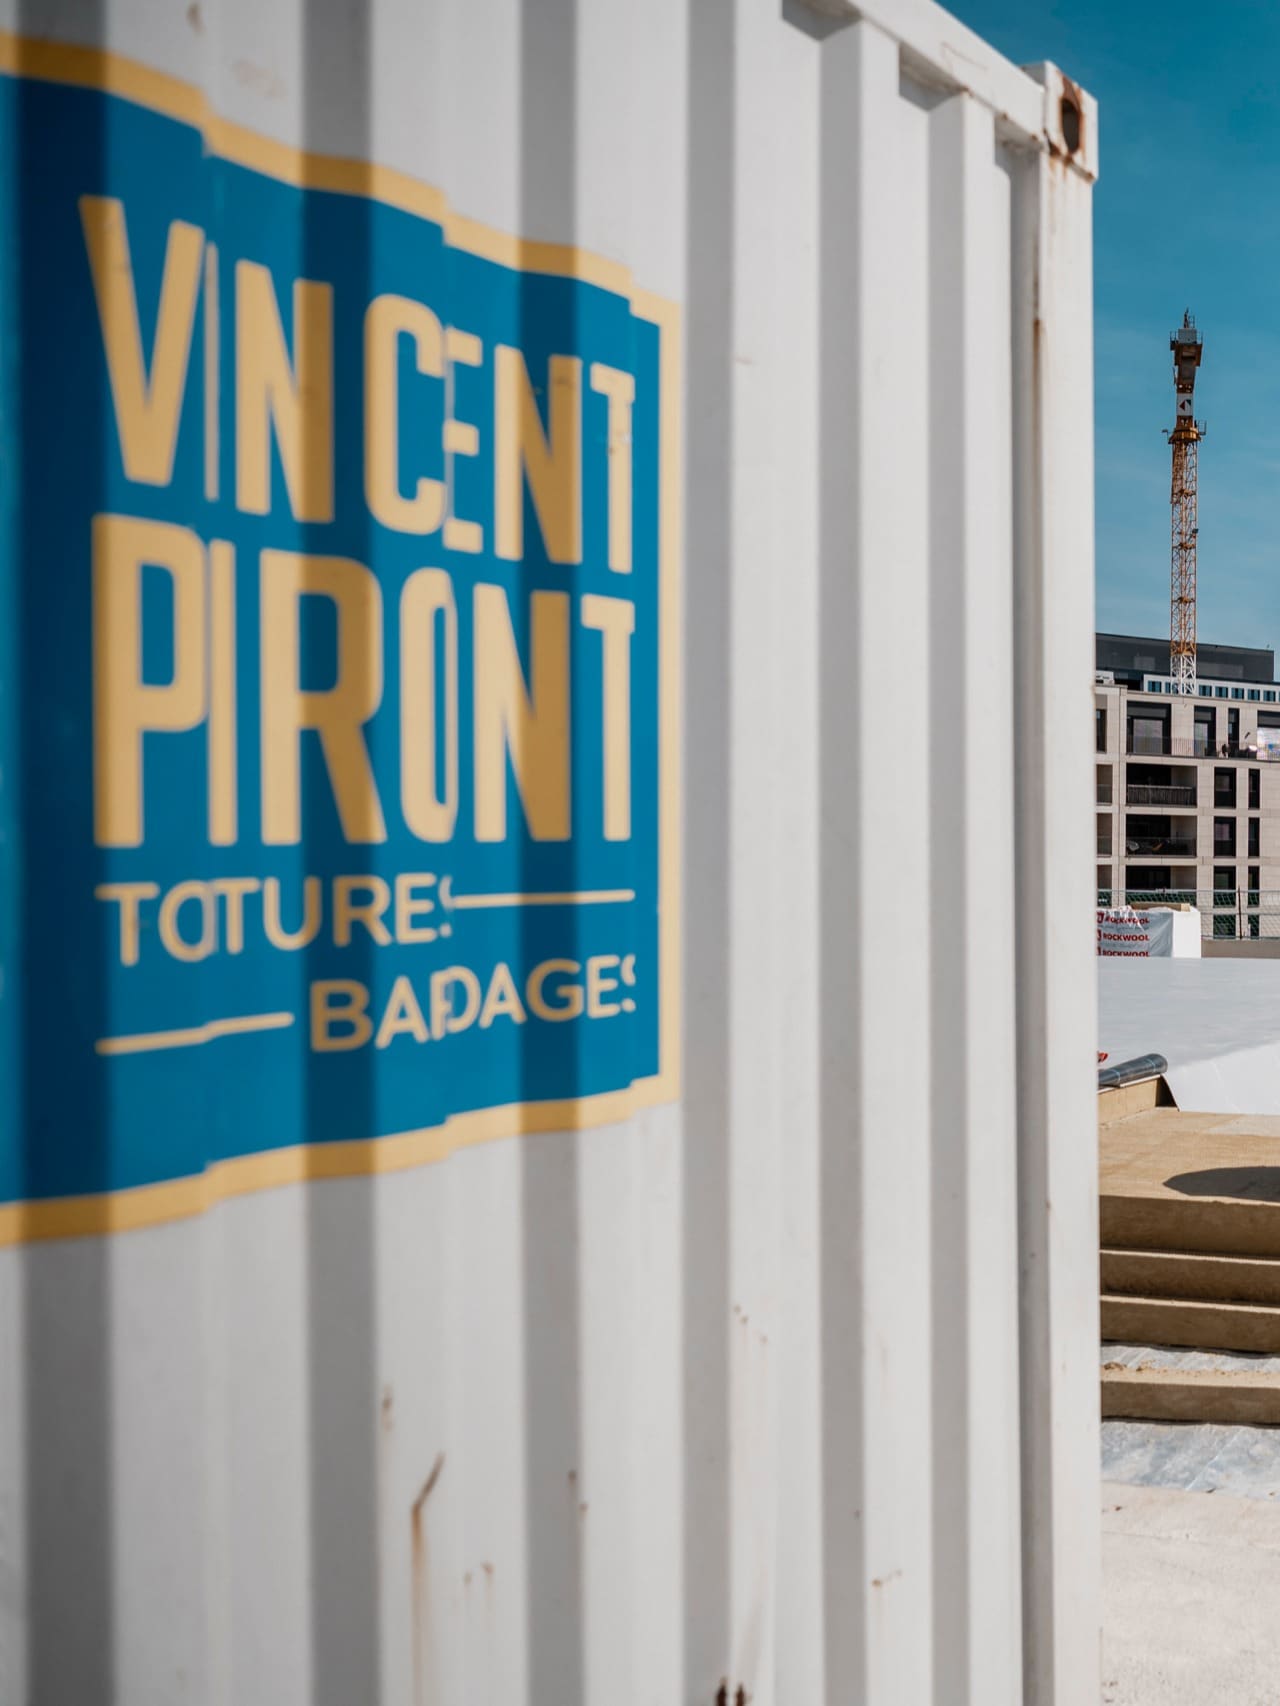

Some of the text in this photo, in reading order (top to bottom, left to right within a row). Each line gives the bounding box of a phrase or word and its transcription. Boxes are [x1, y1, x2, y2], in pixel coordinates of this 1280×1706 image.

[79, 194, 635, 575] VINCENT
[93, 512, 636, 849] PIRONT
[1103, 933, 1150, 941] ROCKWOOL
